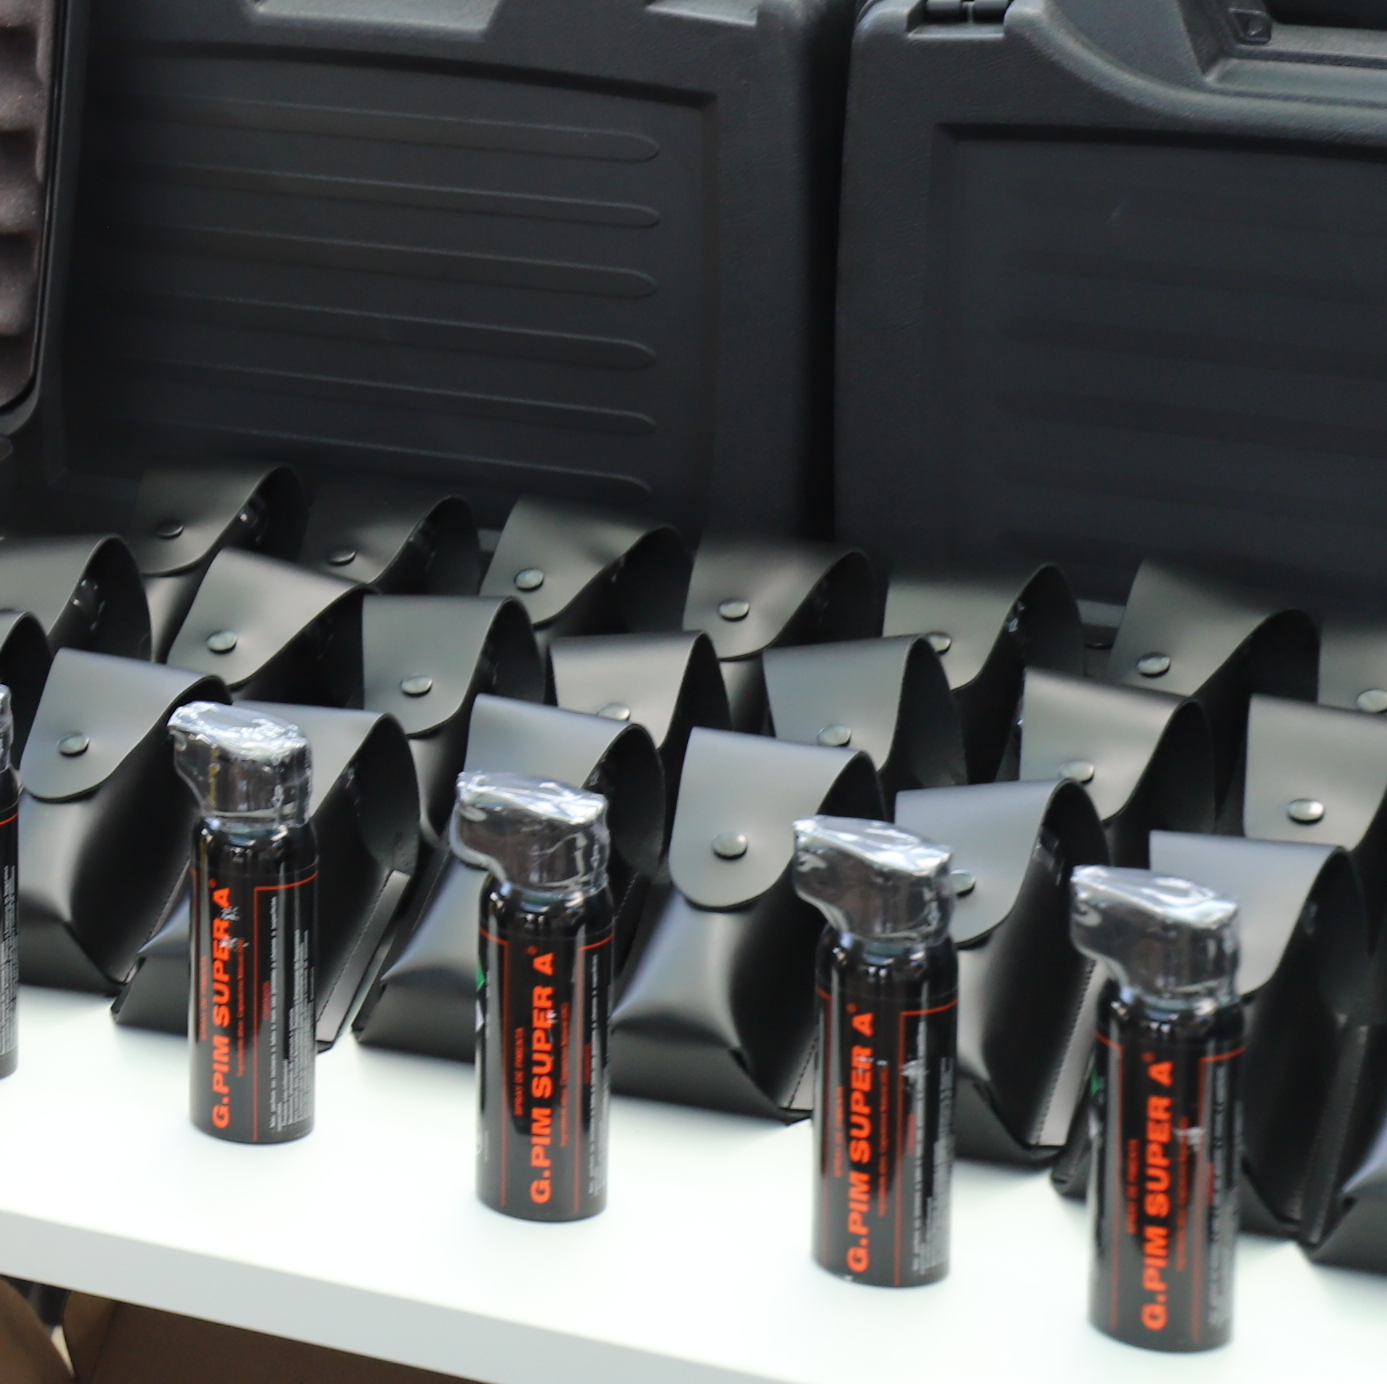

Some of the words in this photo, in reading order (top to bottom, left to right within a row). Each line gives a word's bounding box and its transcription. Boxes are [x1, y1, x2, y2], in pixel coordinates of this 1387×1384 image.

[212, 919, 231, 1027] SUPER
[212, 1034, 231, 1129] G.PIM
[530, 985, 554, 1098] SUPER
[529, 1107, 553, 1204] G.PIM
[848, 1045, 873, 1164] SUPER
[1143, 1095, 1173, 1217] SUPER
[846, 1171, 871, 1273] G.PIM
[1141, 1225, 1169, 1331] G.PIM
